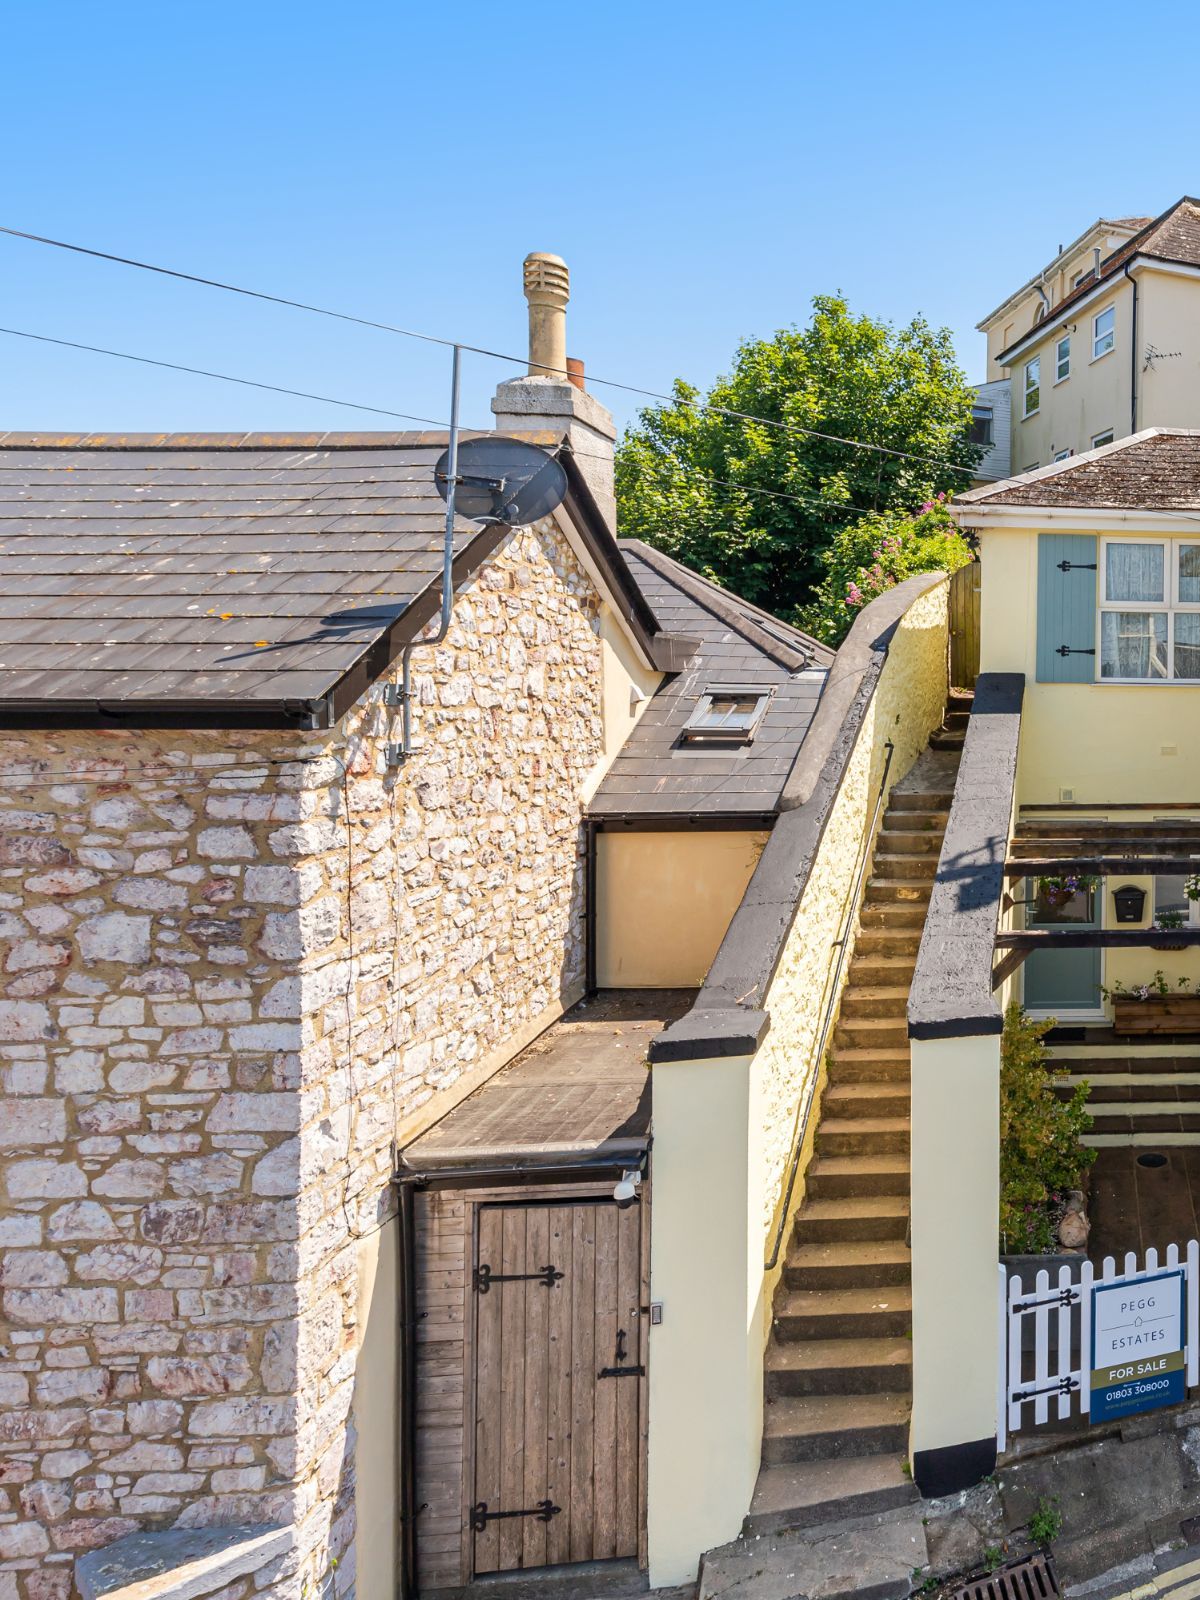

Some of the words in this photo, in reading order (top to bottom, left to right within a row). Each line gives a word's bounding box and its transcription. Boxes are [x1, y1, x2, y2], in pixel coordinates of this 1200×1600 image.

[1120, 1297, 1156, 1313] PEGG
[1112, 1329, 1165, 1350] ESTATES
[1109, 1367, 1134, 1381] FOR
[1137, 1359, 1167, 1376] SALE
[1106, 1387, 1133, 1401] 01803
[1134, 1379, 1170, 1396] 308000
